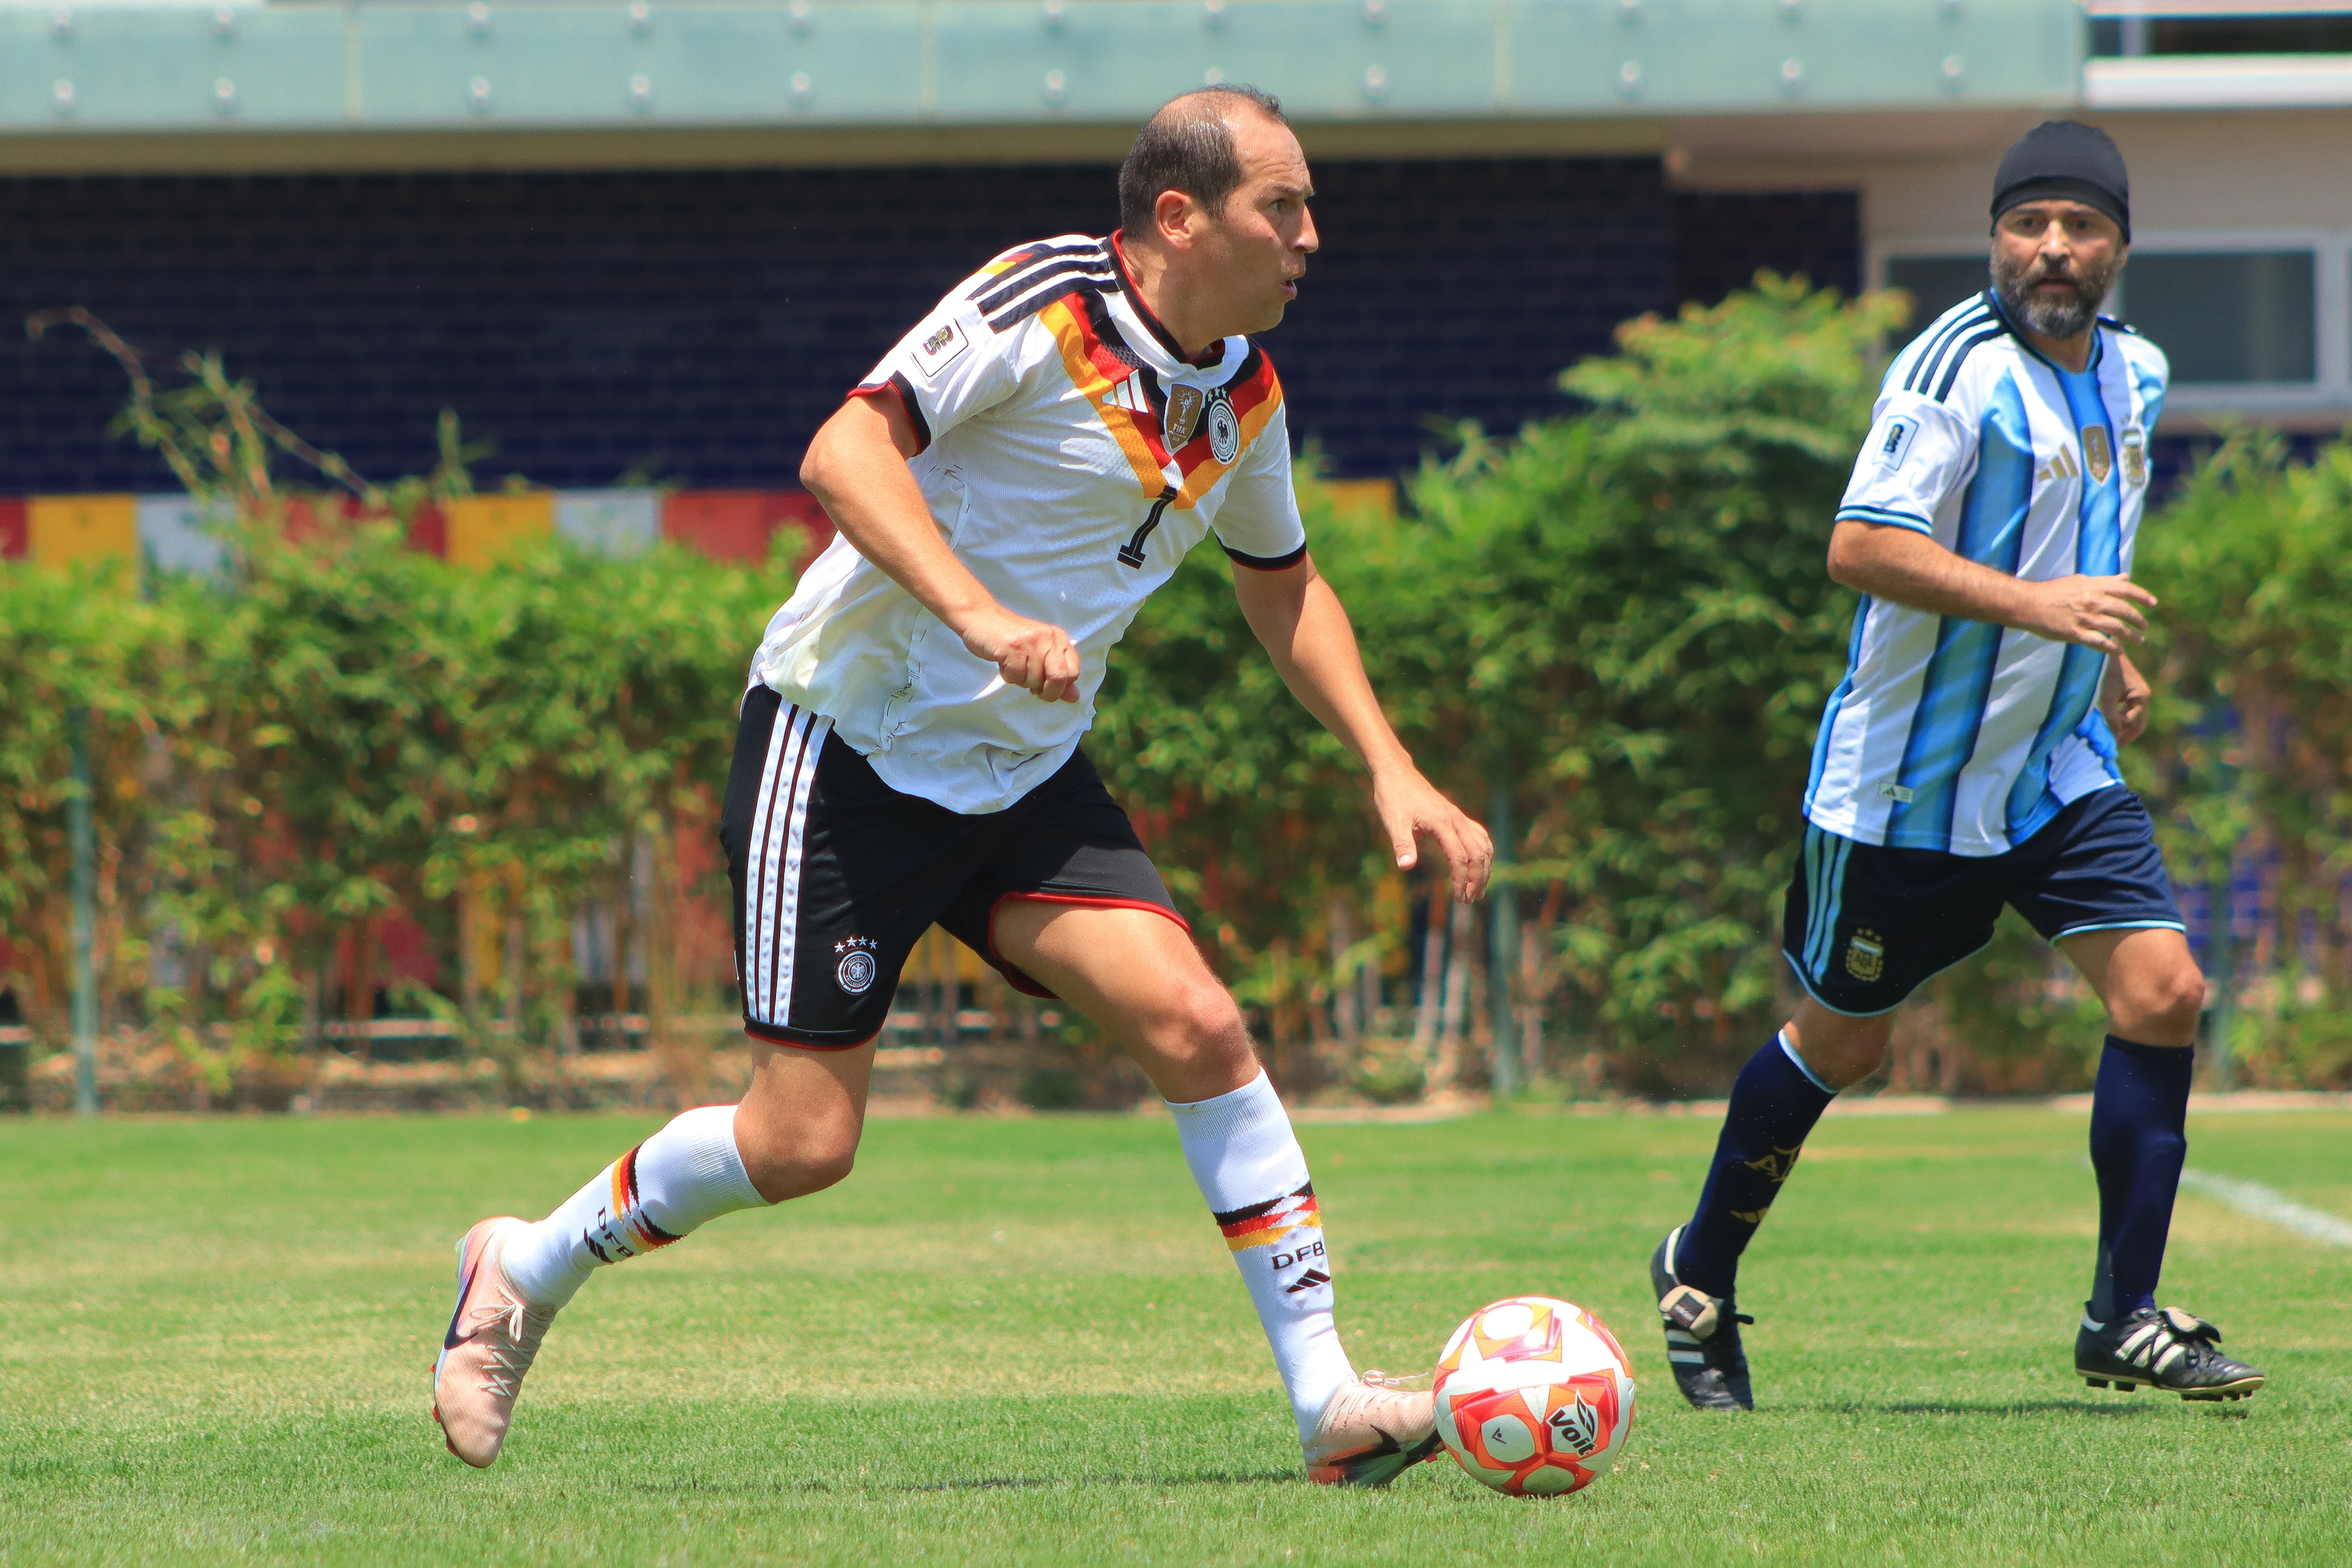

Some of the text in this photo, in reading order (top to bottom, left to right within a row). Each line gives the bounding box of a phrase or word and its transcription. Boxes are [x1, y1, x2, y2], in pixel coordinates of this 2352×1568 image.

[1172, 424, 1185, 434] FIFA
[598, 1206, 635, 1257] DFB
[1272, 1240, 1325, 1270] DFB
